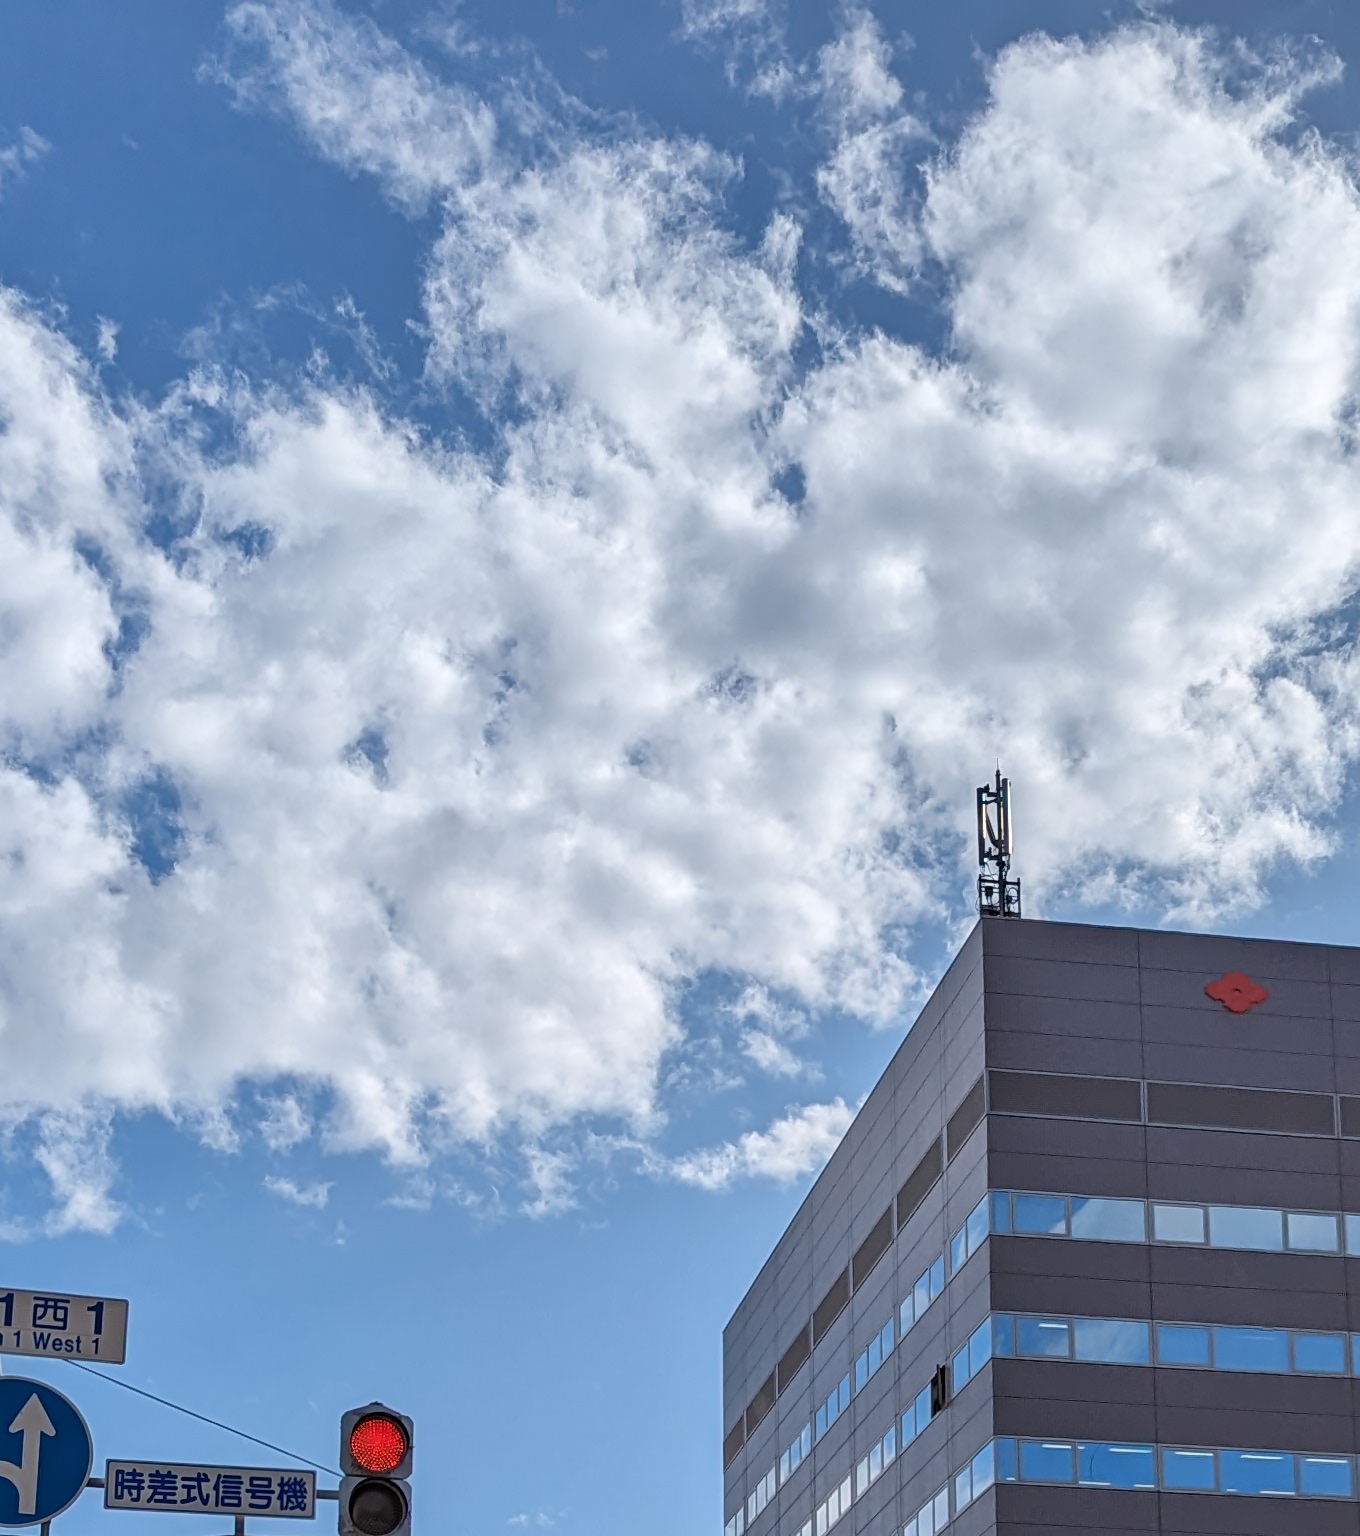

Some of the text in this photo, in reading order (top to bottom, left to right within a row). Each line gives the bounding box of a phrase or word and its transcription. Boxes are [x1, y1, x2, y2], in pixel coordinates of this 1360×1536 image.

[13, 1330, 22, 1348] 1
[33, 1331, 82, 1354] West
[92, 1337, 100, 1355] 1
[114, 1468, 308, 1512] 時差式信号機
